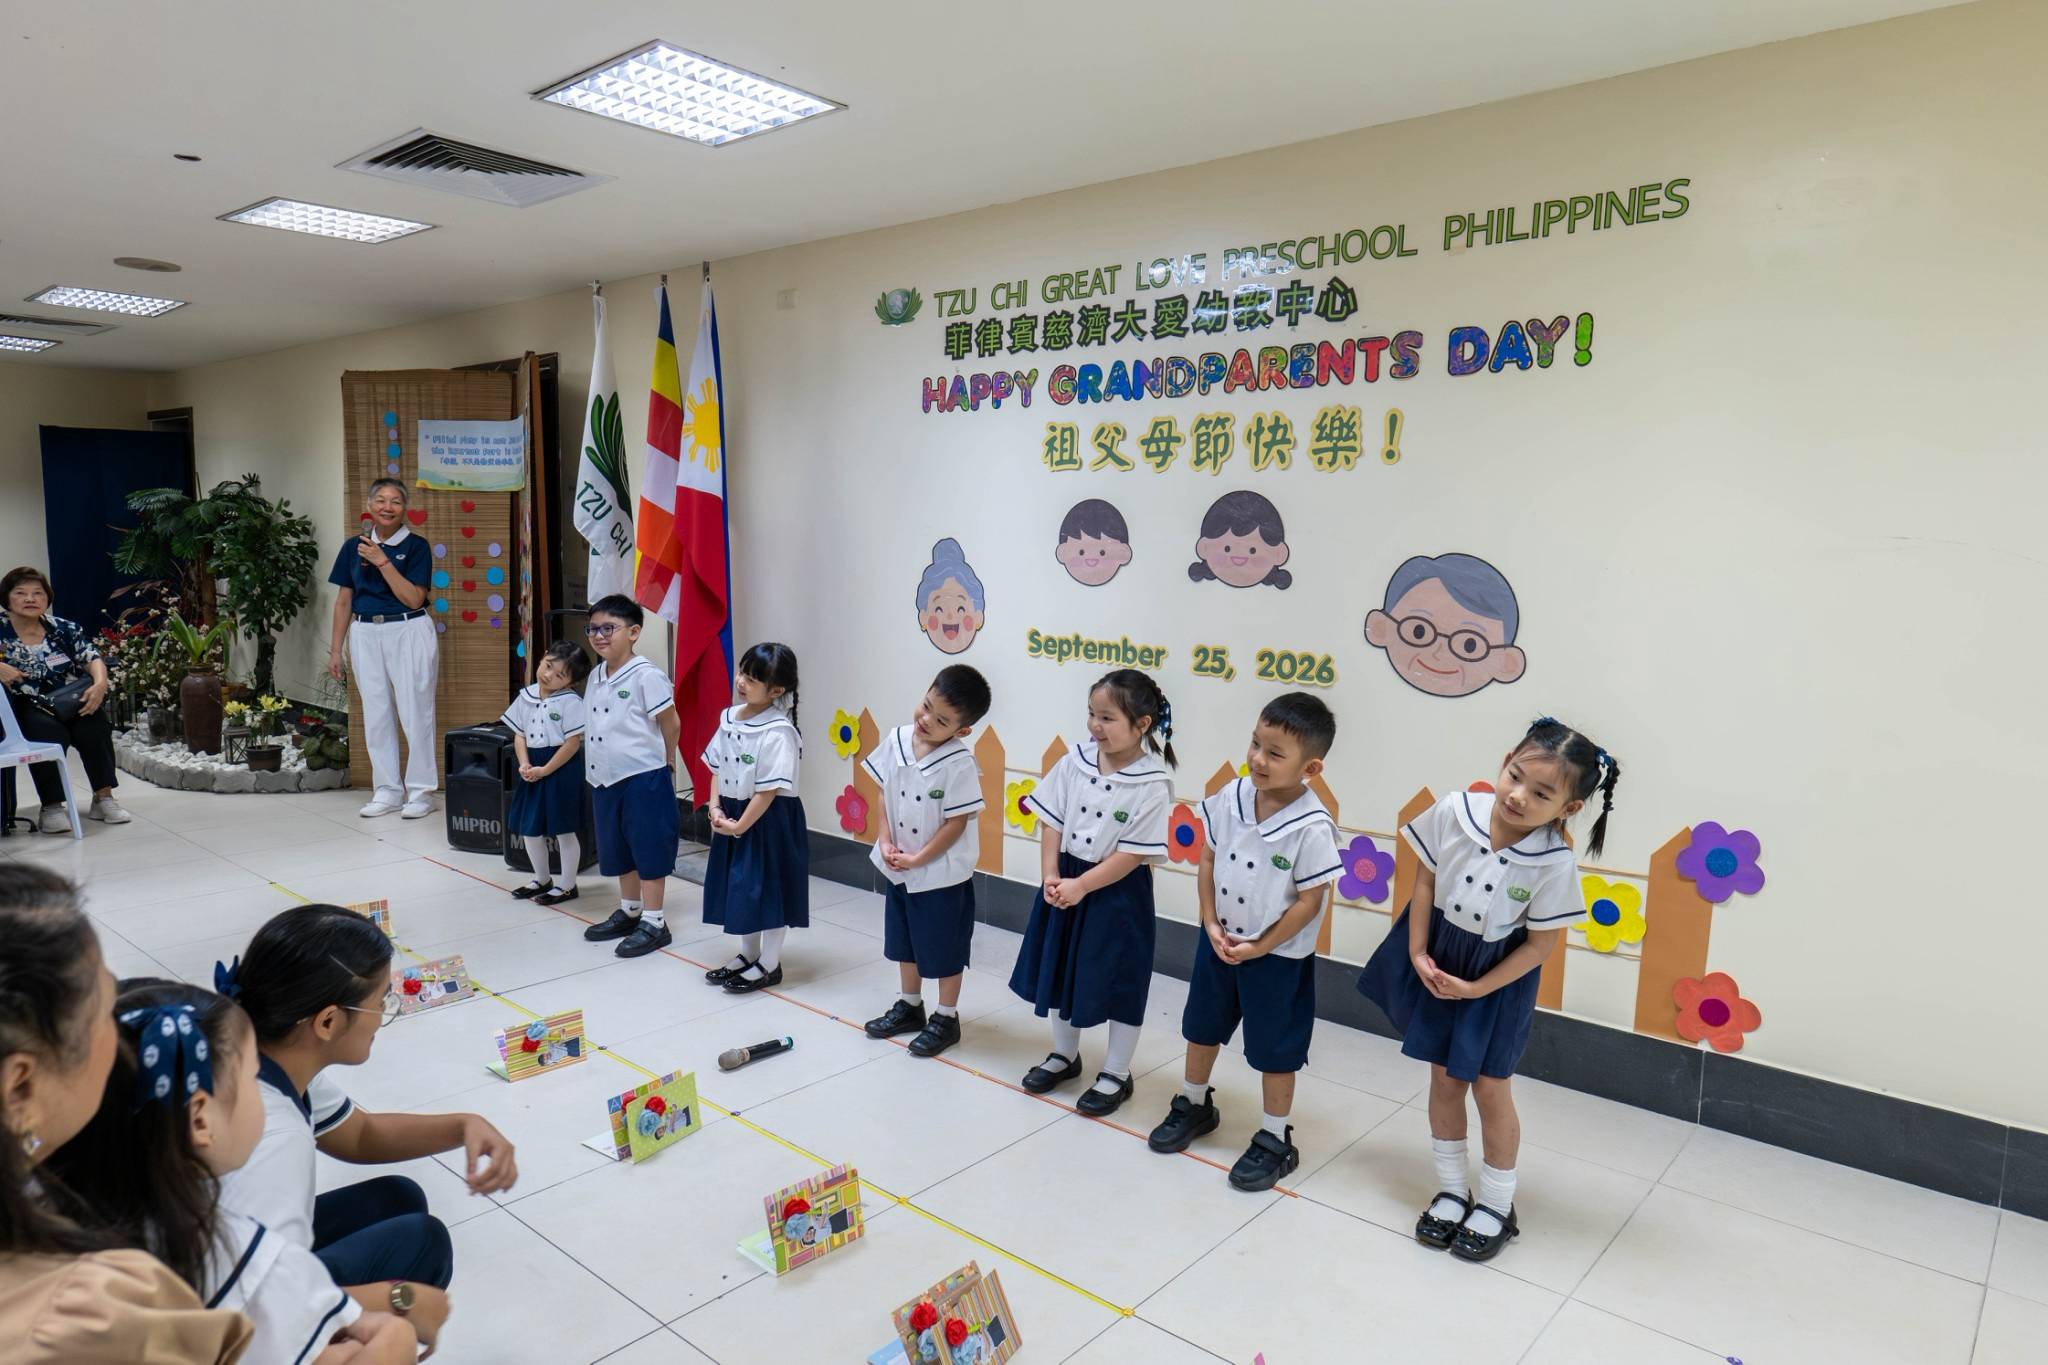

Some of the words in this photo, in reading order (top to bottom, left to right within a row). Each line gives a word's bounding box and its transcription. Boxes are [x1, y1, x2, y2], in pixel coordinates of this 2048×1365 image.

[934, 288, 977, 318] TZU
[990, 279, 1028, 311] CHI
[1041, 264, 1122, 304] GREAT
[1136, 252, 1207, 291] LOVE
[1222, 224, 1418, 281] PRESCHOOL
[1443, 178, 1691, 251] PHILIPPINES
[944, 276, 1358, 360] 菲律賓慈濟大愛幼教中心
[922, 368, 1039, 414] HAPPY
[1047, 330, 1424, 406] GRANDPARENTS
[1447, 312, 1595, 377] DAY!
[576, 480, 613, 521] TZU
[610, 521, 633, 559] CHI
[1027, 629, 1168, 668] September
[1192, 646, 1235, 681] 25,
[1256, 649, 1336, 684] 2026
